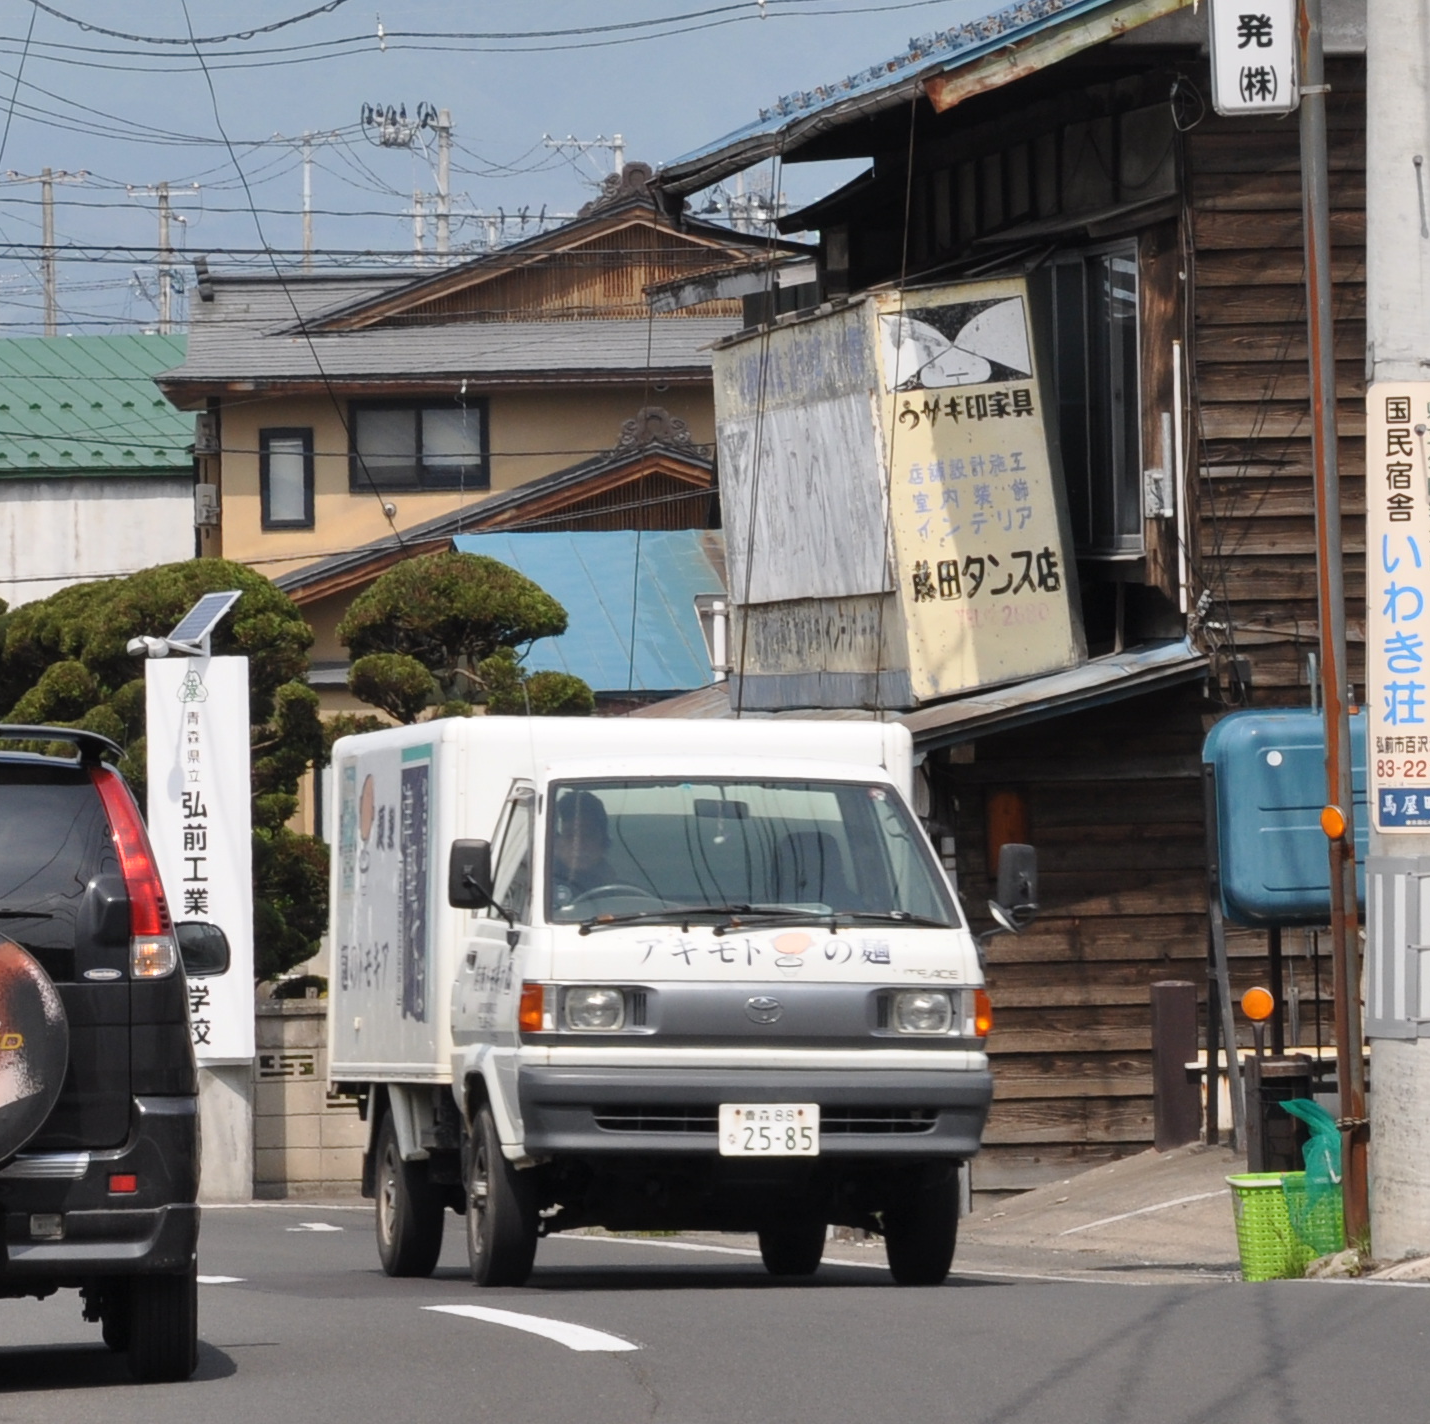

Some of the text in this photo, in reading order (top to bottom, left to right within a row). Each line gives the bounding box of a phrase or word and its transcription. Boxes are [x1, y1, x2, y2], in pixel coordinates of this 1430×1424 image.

[1385, 396, 1414, 522] 国民宿舎
[917, 506, 1033, 540] インテリア
[912, 546, 1061, 603] 藤田タンス店
[1382, 533, 1425, 726] いわき荘
[187, 711, 200, 782] 青森県立
[182, 791, 212, 1046] 弘前工業学校
[635, 937, 761, 967] アキモト
[743, 1126, 813, 1151] 25-85
